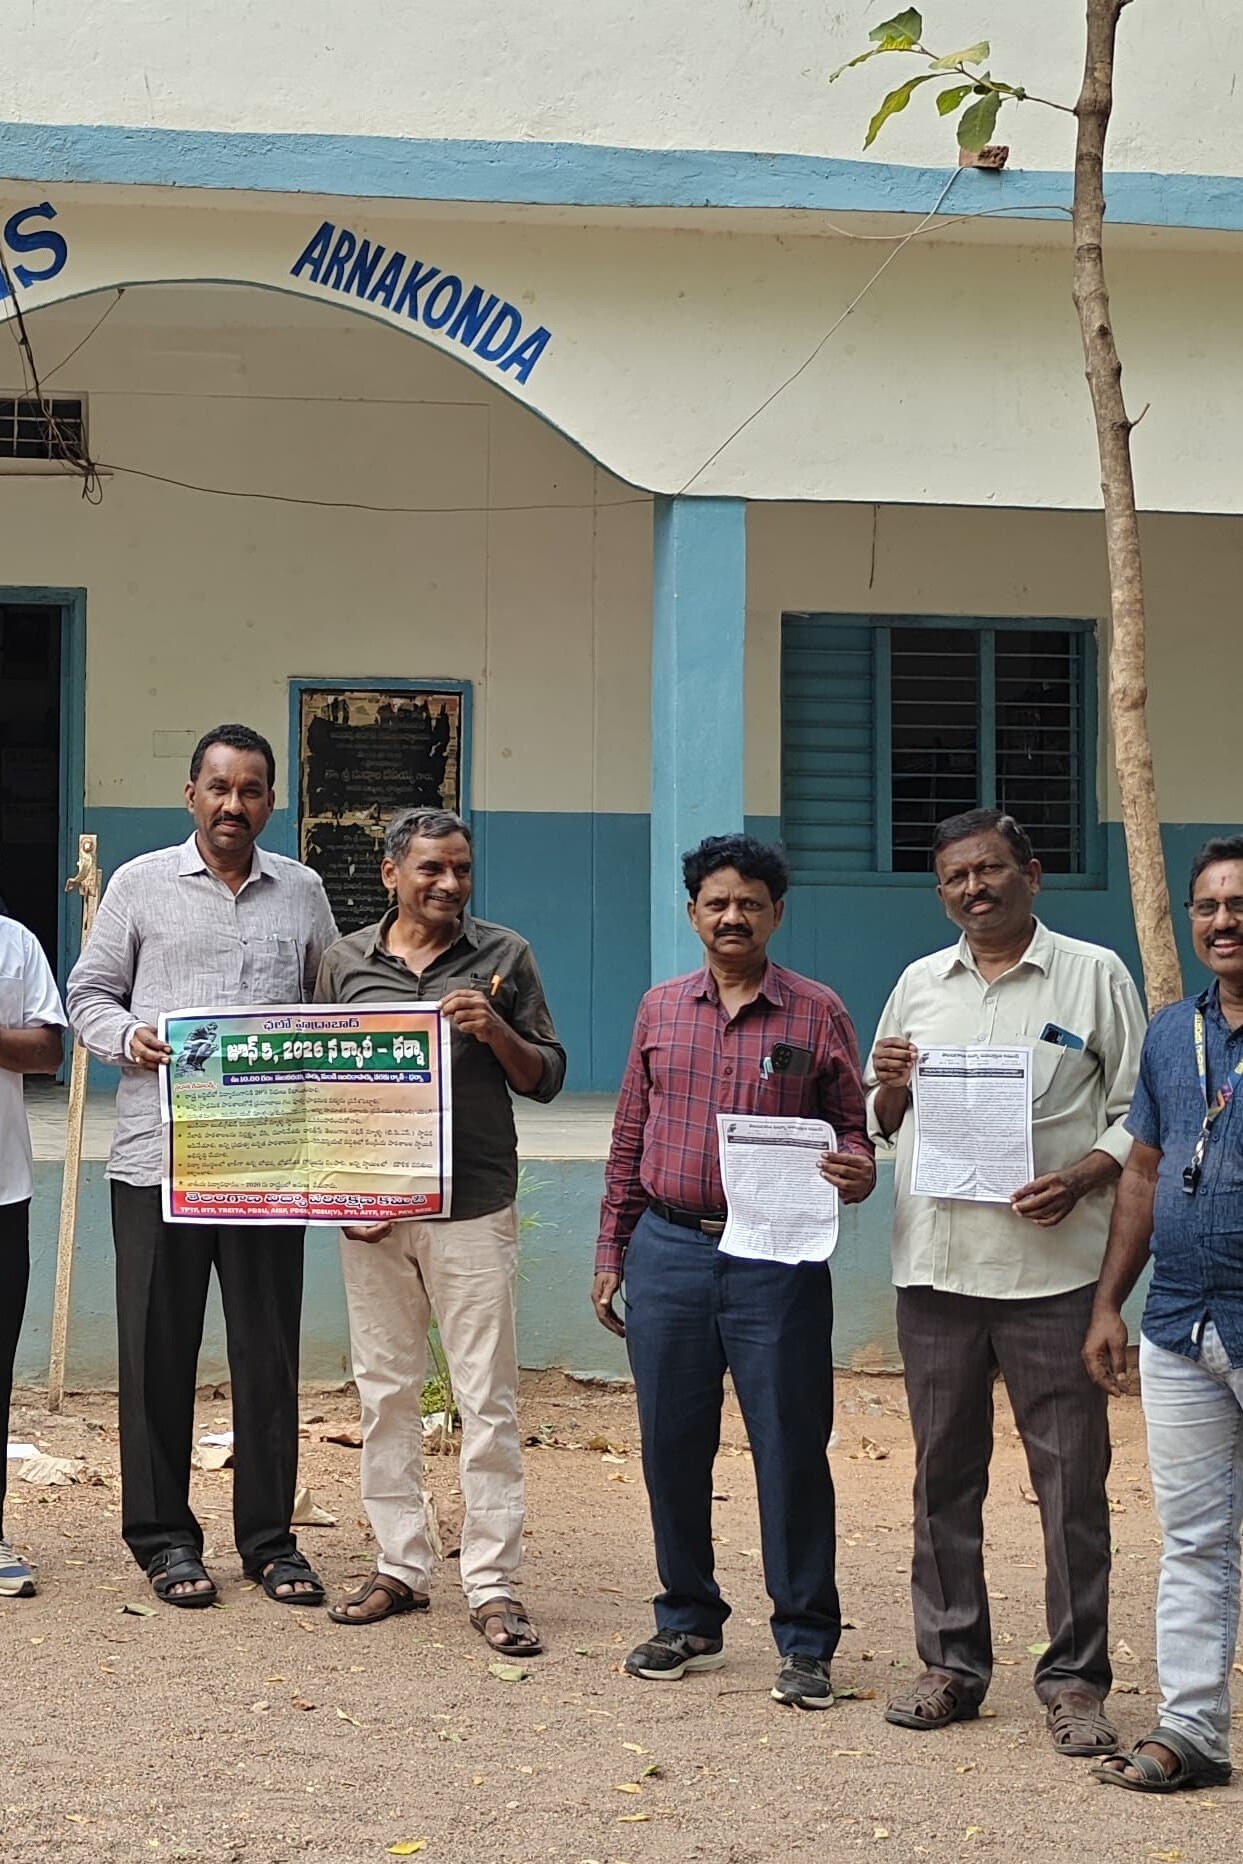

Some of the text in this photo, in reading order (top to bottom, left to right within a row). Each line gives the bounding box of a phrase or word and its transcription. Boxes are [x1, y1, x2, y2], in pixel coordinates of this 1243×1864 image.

[289, 220, 552, 386] ARNAKONDA
[227, 1035, 259, 1067] జూన్
[283, 1040, 324, 1061] 2026
